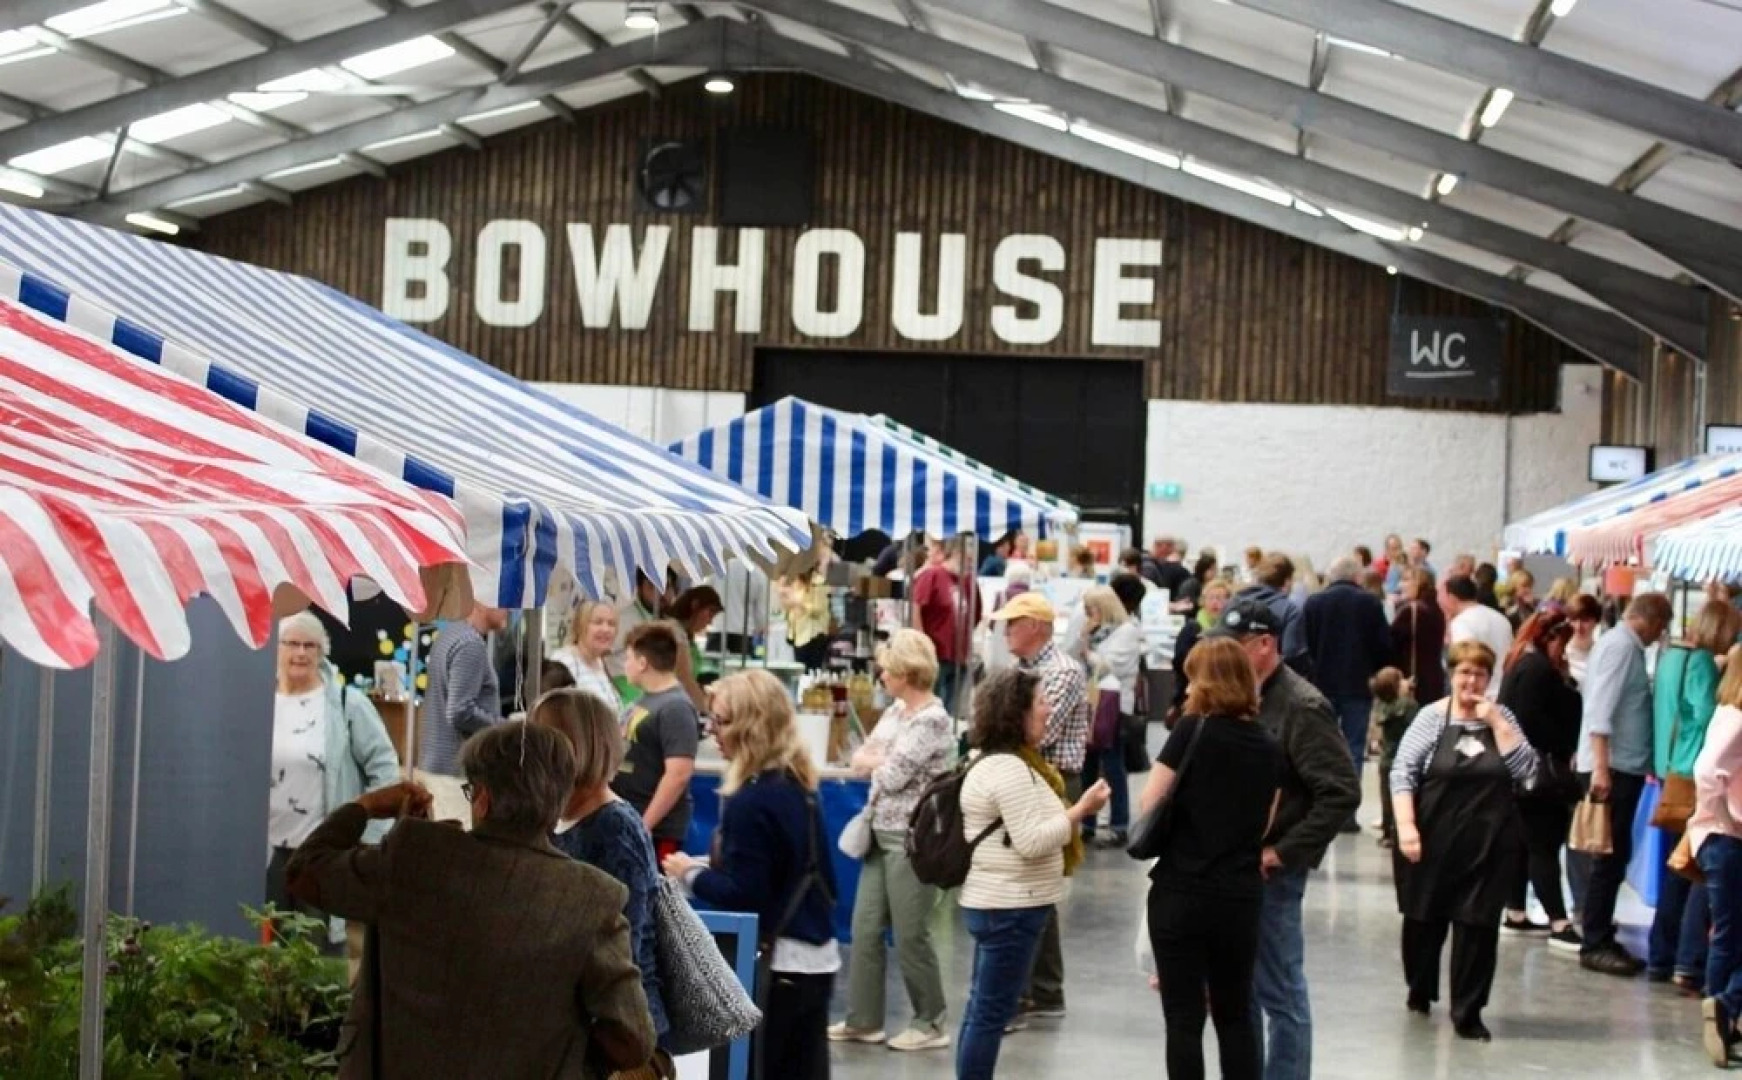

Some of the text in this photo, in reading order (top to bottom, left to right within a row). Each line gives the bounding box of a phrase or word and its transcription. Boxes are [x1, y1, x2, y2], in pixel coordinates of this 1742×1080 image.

[382, 217, 1163, 347] BOWHOUSE
[1411, 330, 1466, 368] WC
[1608, 459, 1629, 471] WC
